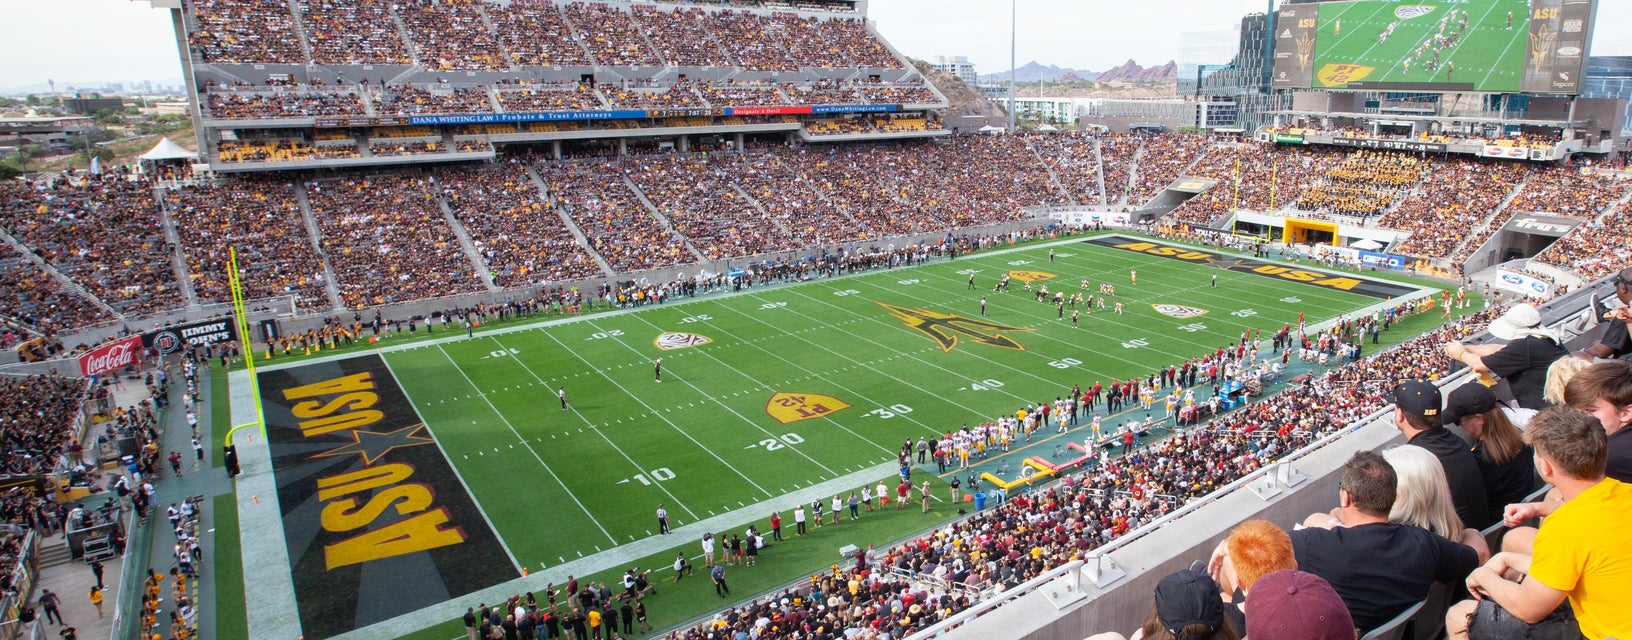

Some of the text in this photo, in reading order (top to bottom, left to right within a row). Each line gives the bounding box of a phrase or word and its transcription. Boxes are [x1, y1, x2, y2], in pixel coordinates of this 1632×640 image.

[1533, 7, 1558, 20] ASU
[1298, 18, 1315, 28] ASU
[734, 107, 760, 115] Designate
[413, 116, 438, 124] DANA
[439, 115, 476, 123] WHITING
[477, 114, 494, 122] LAW
[1115, 242, 1362, 291] ASU USA
[181, 322, 226, 338] JIMMY
[187, 331, 230, 345] OHN'S
[87, 341, 133, 376] Coca-Cola
[1048, 357, 1083, 370] 50
[971, 379, 1005, 391] 40
[281, 371, 386, 438] USA
[775, 395, 806, 408] 42
[795, 403, 831, 418] PT
[870, 403, 913, 419] 30
[759, 432, 805, 451] 20
[629, 467, 676, 486] 10
[317, 463, 468, 571] ASU
